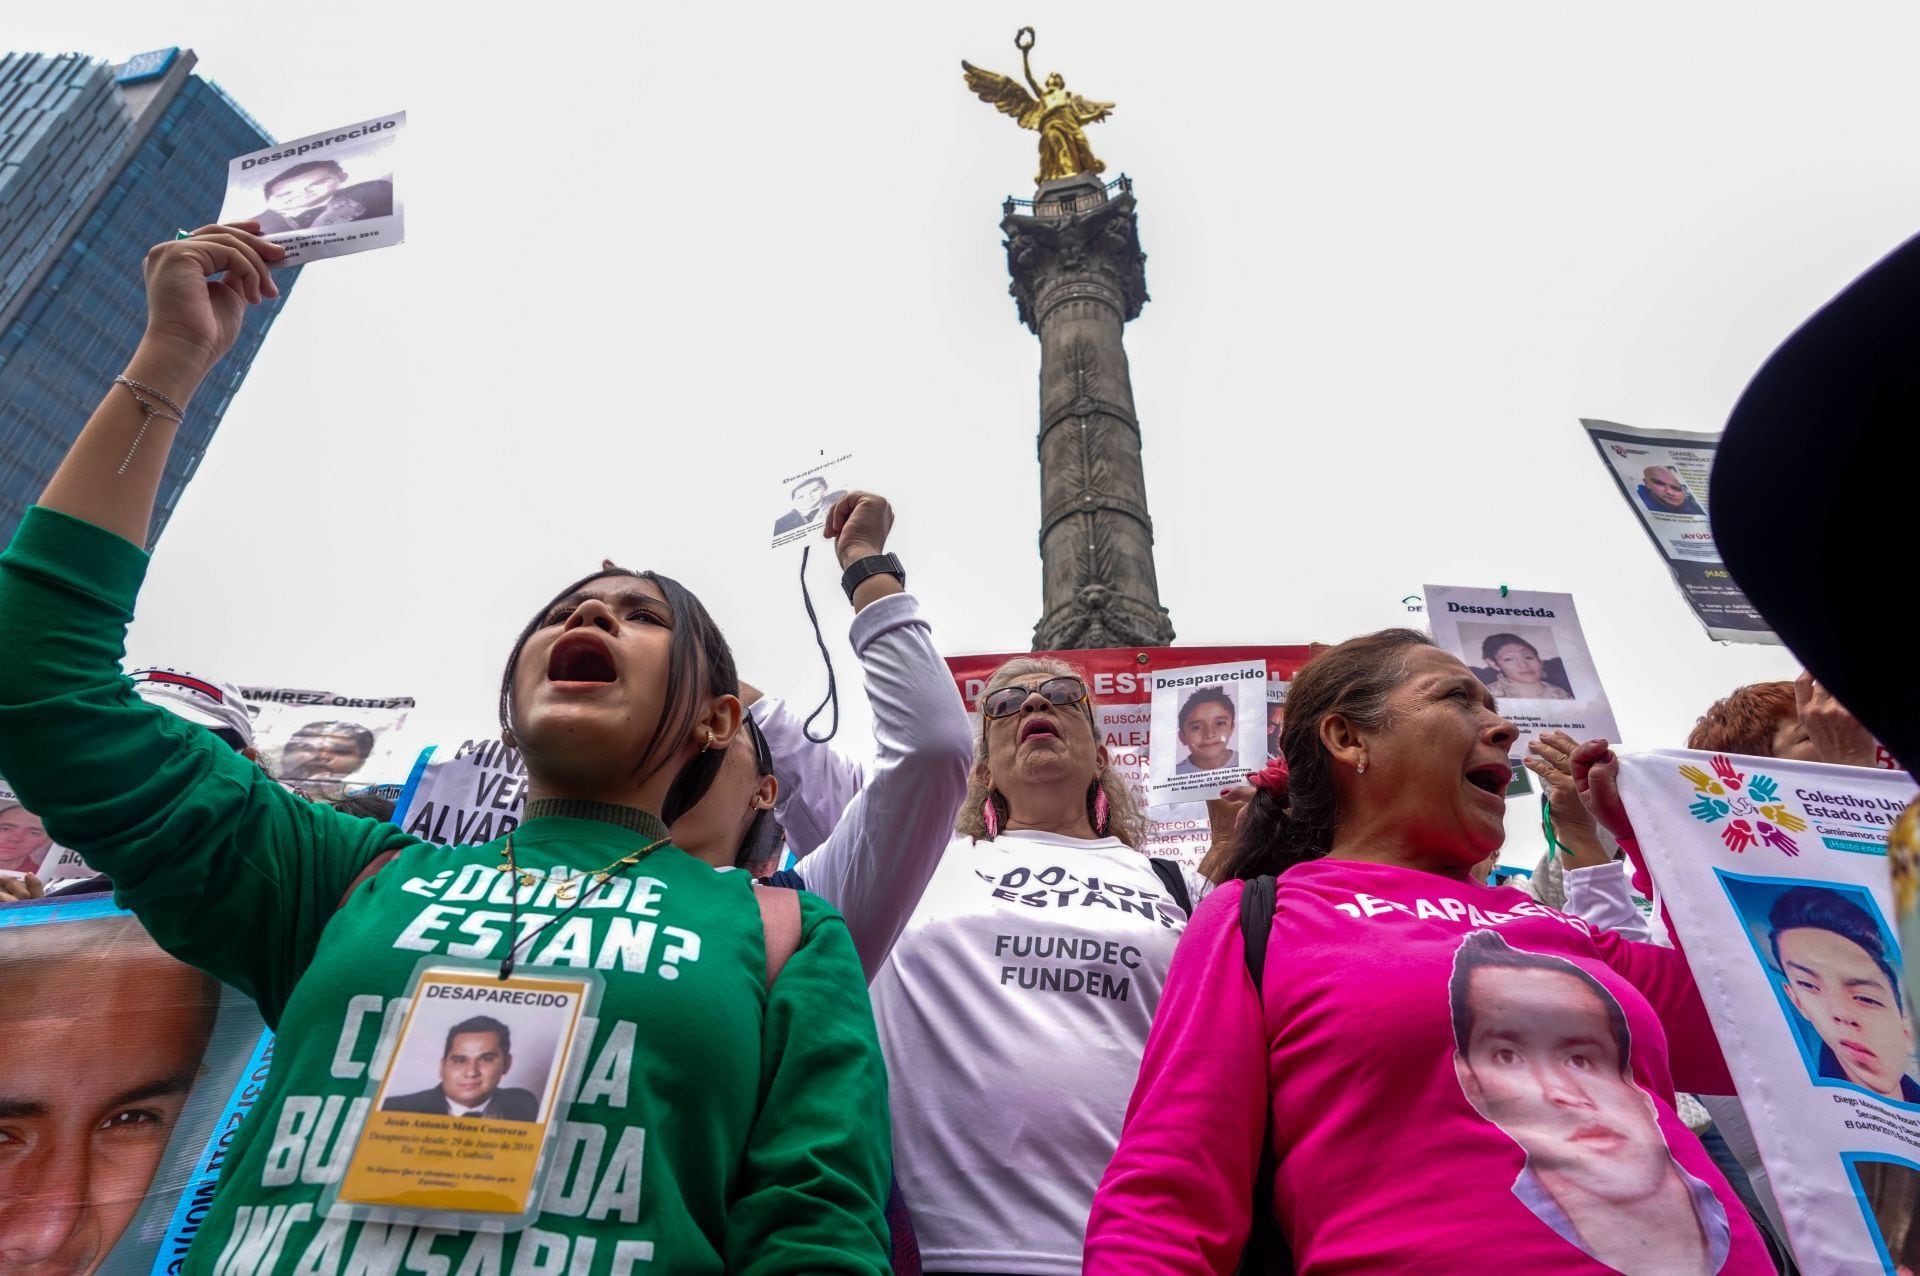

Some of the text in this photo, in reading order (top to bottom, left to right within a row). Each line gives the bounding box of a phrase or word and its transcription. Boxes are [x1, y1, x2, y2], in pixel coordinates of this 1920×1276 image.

[241, 120, 396, 170] Desaparecido
[783, 453, 853, 485] Desaparecido
[1446, 601, 1556, 619] Desaparecida
[1156, 668, 1265, 690] Desaparecido
[1104, 714, 1151, 725] BUSCAM
[1795, 788, 1876, 809] Colectivo
[1802, 803, 1862, 822] Estado
[1864, 812, 1886, 825] de
[1816, 825, 1875, 840] Caminamos
[401, 863, 669, 917] ¿DONDE
[392, 903, 702, 981] ESTAN?
[995, 934, 1142, 970] FUUNDEC
[1000, 965, 1130, 1002] FUNDEM
[426, 983, 569, 1009] DESAPARECIDO
[1833, 1094, 1859, 1106] Diego
[480, 1124, 528, 1137] Contreras
[1844, 1120, 1855, 1129] El
